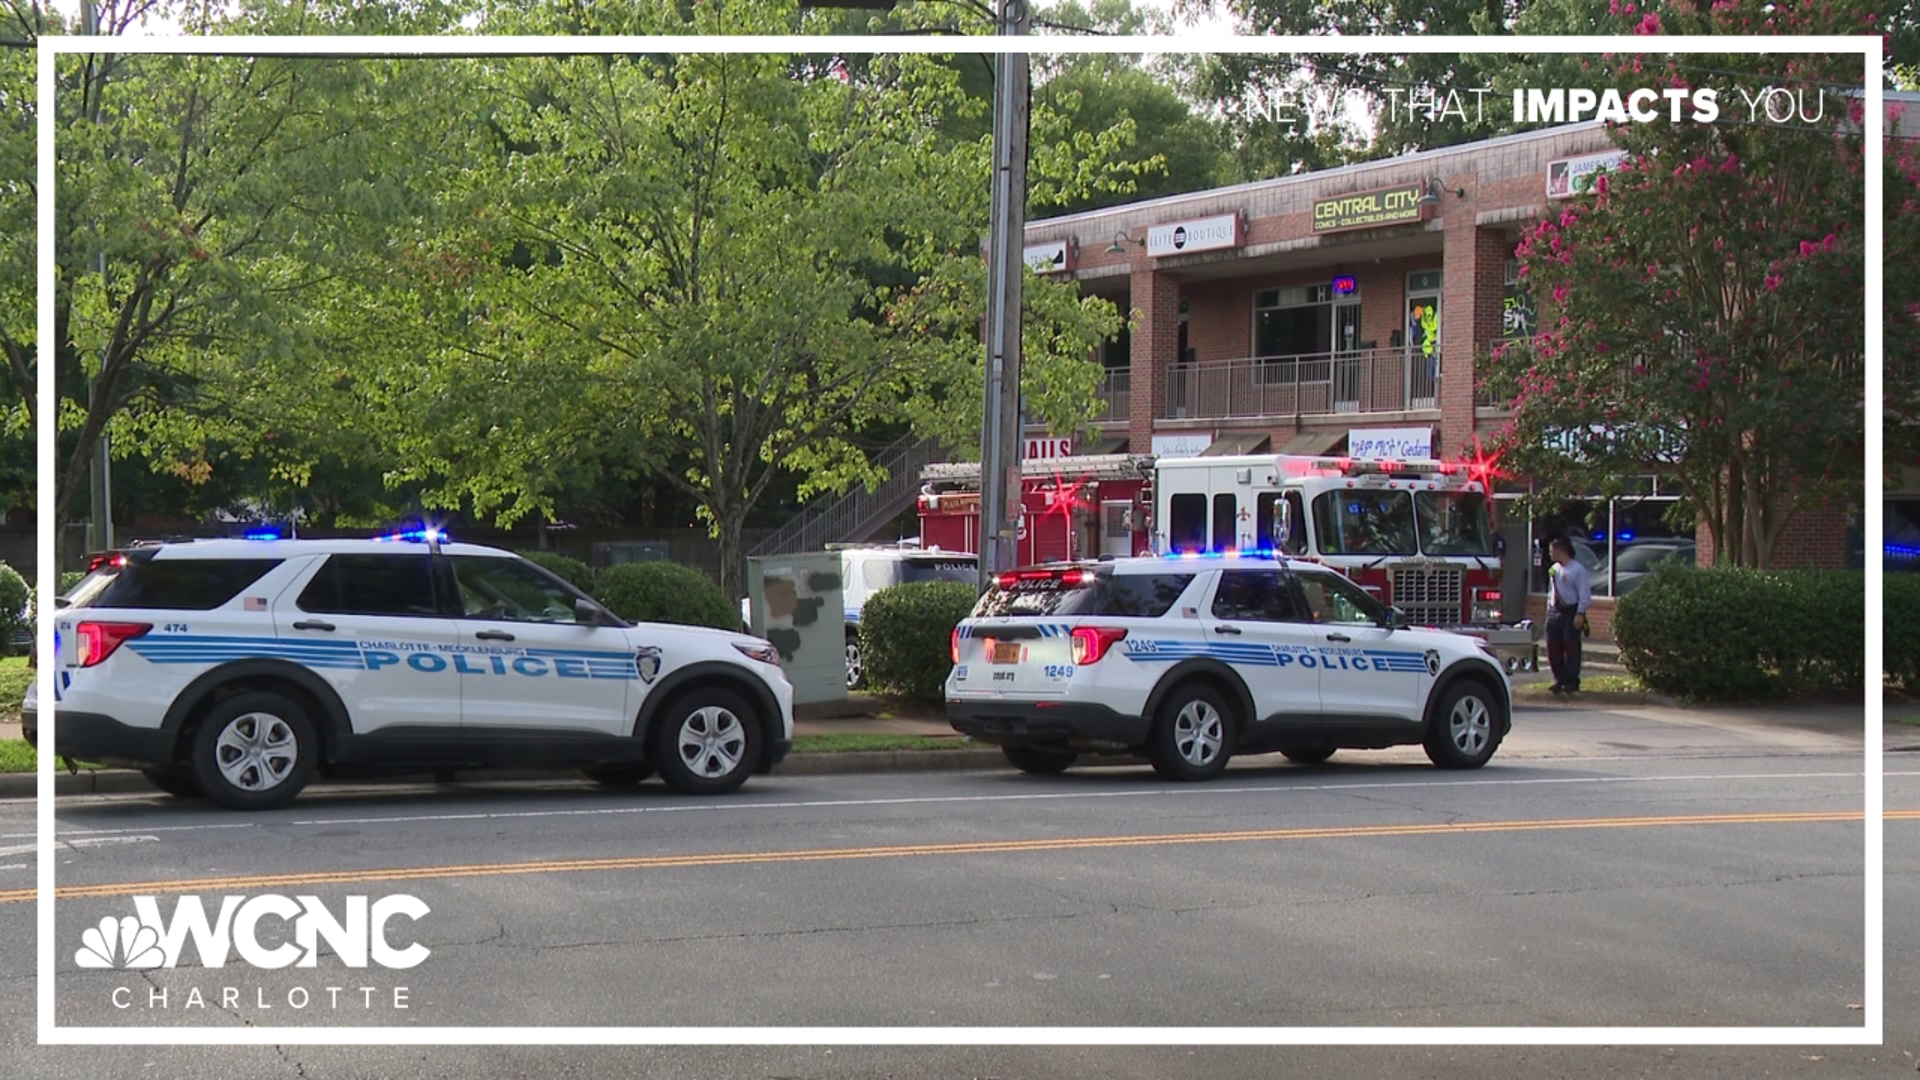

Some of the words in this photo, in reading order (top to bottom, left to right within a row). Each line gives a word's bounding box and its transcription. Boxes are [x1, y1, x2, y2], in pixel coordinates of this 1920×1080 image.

[1315, 195, 1382, 219] CENTRAL
[1385, 189, 1419, 211] CITY
[1315, 219, 1336, 230] COMICS
[1399, 208, 1418, 218] MORE
[1188, 224, 1234, 242] BOUTIQUE
[1023, 440, 1069, 458] AILS
[934, 563, 978, 571] POLICE
[1009, 578, 1060, 590] POLICE
[163, 623, 188, 633] 474
[1124, 639, 1157, 653] 1249
[363, 651, 590, 679] POLICE
[1277, 652, 1390, 672] POLICE
[1043, 665, 1074, 678] 1249
